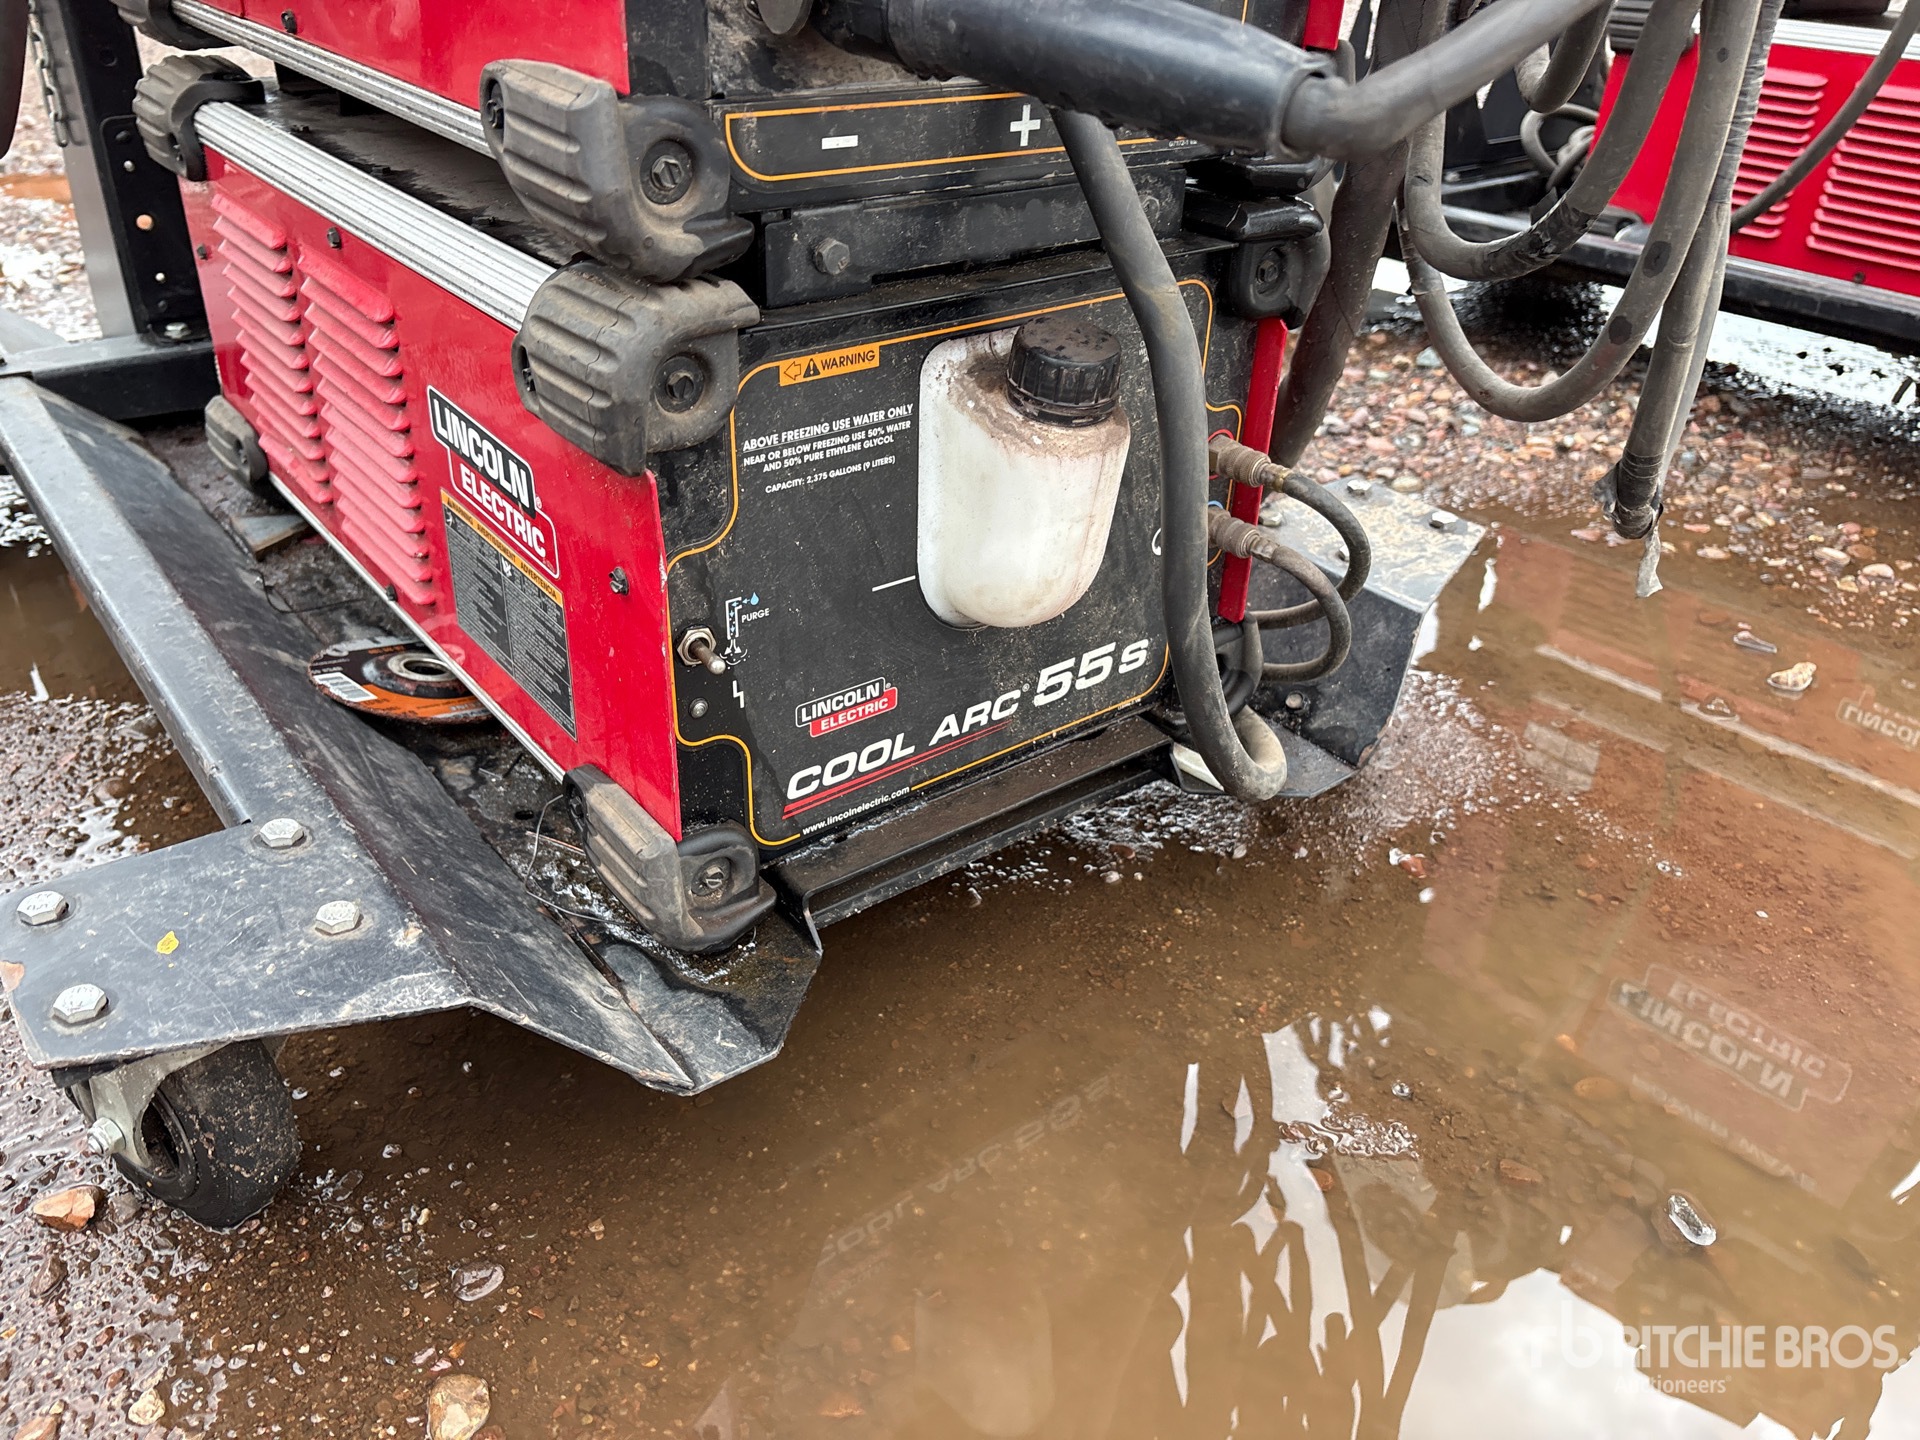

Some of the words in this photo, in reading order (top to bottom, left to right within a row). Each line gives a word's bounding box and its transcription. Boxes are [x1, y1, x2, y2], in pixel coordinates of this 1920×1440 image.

[820, 349, 876, 371] WARNING
[743, 433, 779, 451] ABOVE
[781, 422, 830, 443] FREEZING
[832, 417, 851, 431] USE
[853, 410, 886, 427] WATER
[887, 403, 914, 418] ONLY
[743, 453, 766, 467] NEAR
[767, 450, 781, 461] OR
[782, 443, 812, 458] BELOW
[812, 434, 850, 451] FREEZING
[851, 430, 866, 442] USE
[867, 426, 885, 438] 50%
[886, 420, 912, 433] WATER
[433, 398, 530, 509] LINCOLN
[762, 460, 782, 473] AND
[783, 456, 802, 469] 50%
[803, 451, 825, 464] PURE
[825, 442, 862, 458] ETHYLENE
[863, 434, 895, 449] GLYCOL
[765, 478, 806, 494] CAPACITY:
[828, 463, 863, 478] GALLONS
[863, 460, 871, 473] (9
[871, 454, 896, 469] LITERS)
[459, 462, 547, 559] ELECTRIC
[741, 608, 770, 623] PURGE
[801, 682, 880, 723] LINCOLN
[820, 698, 888, 731] ELECTRIC
[786, 732, 916, 800] COOL
[802, 786, 911, 836] www.lincolnelectric.com
